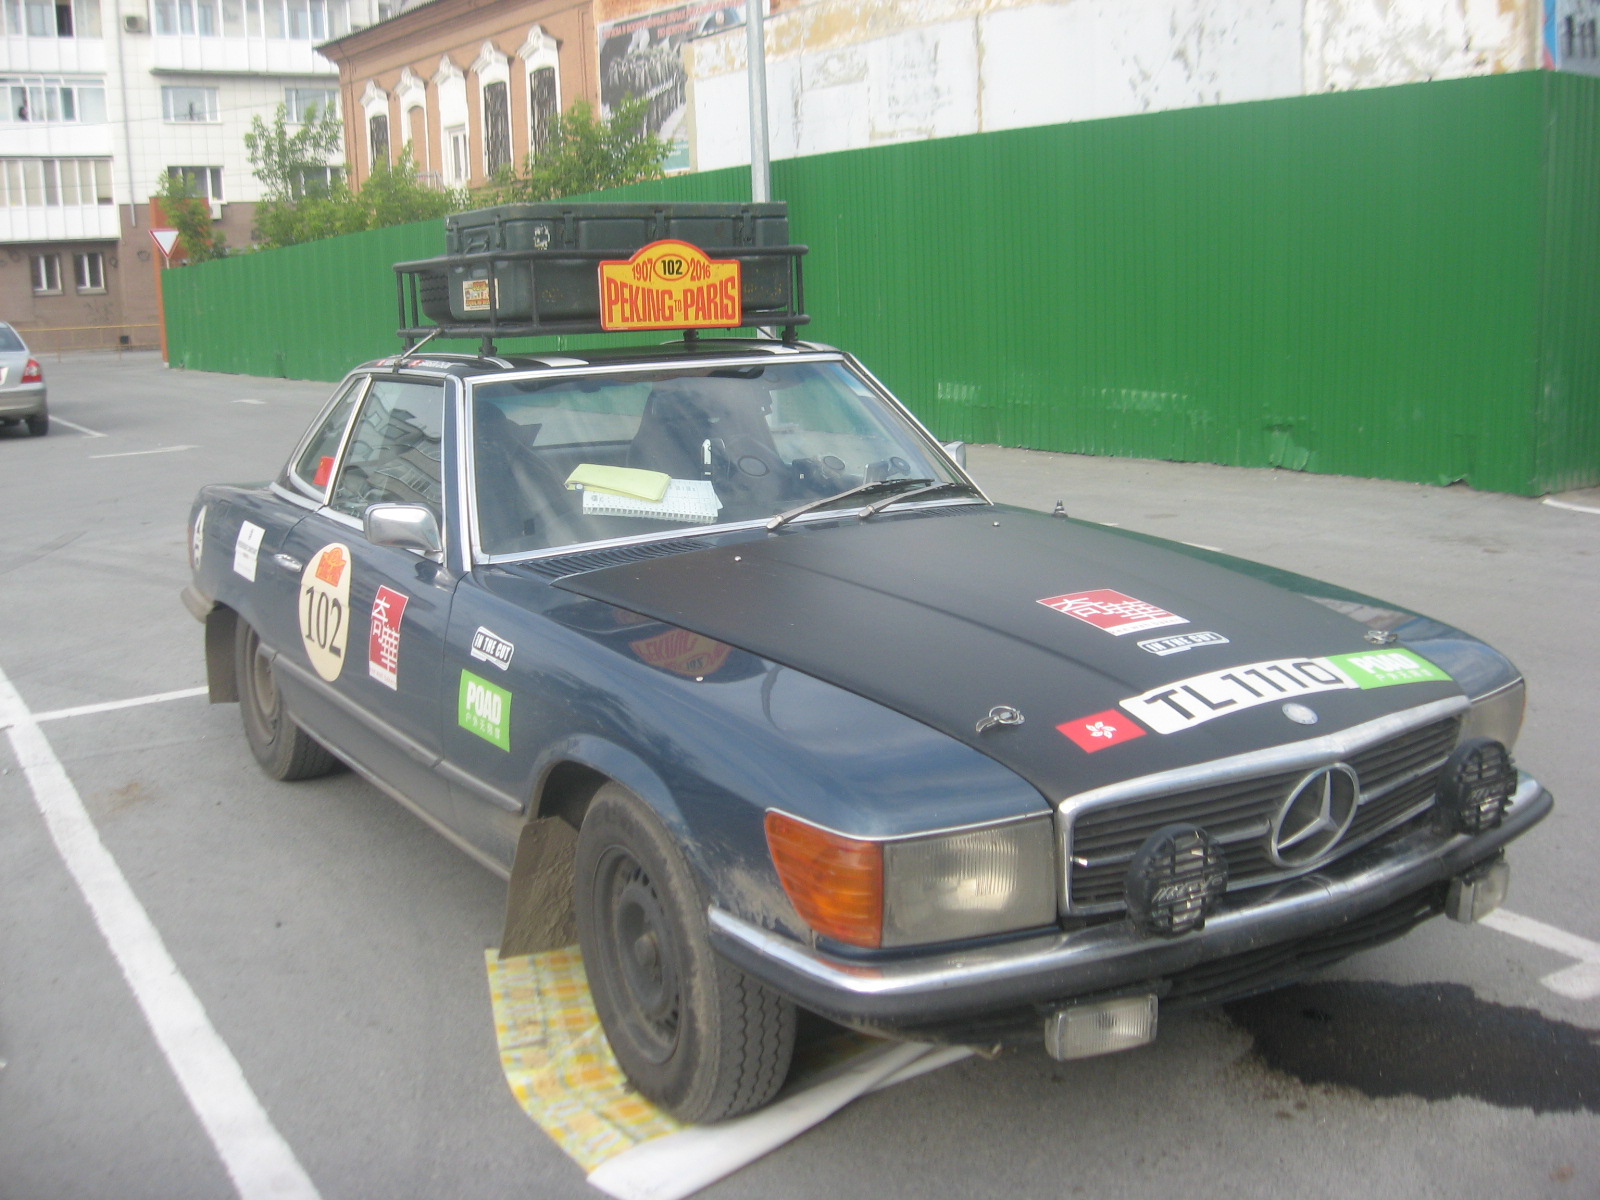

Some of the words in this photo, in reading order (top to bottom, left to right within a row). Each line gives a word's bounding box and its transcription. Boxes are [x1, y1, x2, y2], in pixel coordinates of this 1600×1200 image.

[632, 258, 653, 282] 1907
[661, 259, 683, 275] 102
[690, 257, 711, 282] 2016
[606, 276, 674, 323] PEKING
[674, 299, 682, 313] TO
[683, 276, 736, 320] PARIS
[305, 586, 342, 659] 102
[1051, 597, 1169, 620] 奇華
[371, 596, 400, 672] 奇華
[474, 633, 485, 649] IN
[482, 636, 497, 655] THE
[495, 642, 512, 661] CUT
[1145, 642, 1167, 652] IN
[1161, 637, 1193, 648] THE
[1188, 633, 1218, 643] CUT
[1346, 652, 1420, 674] POAD
[466, 681, 502, 725] POAD
